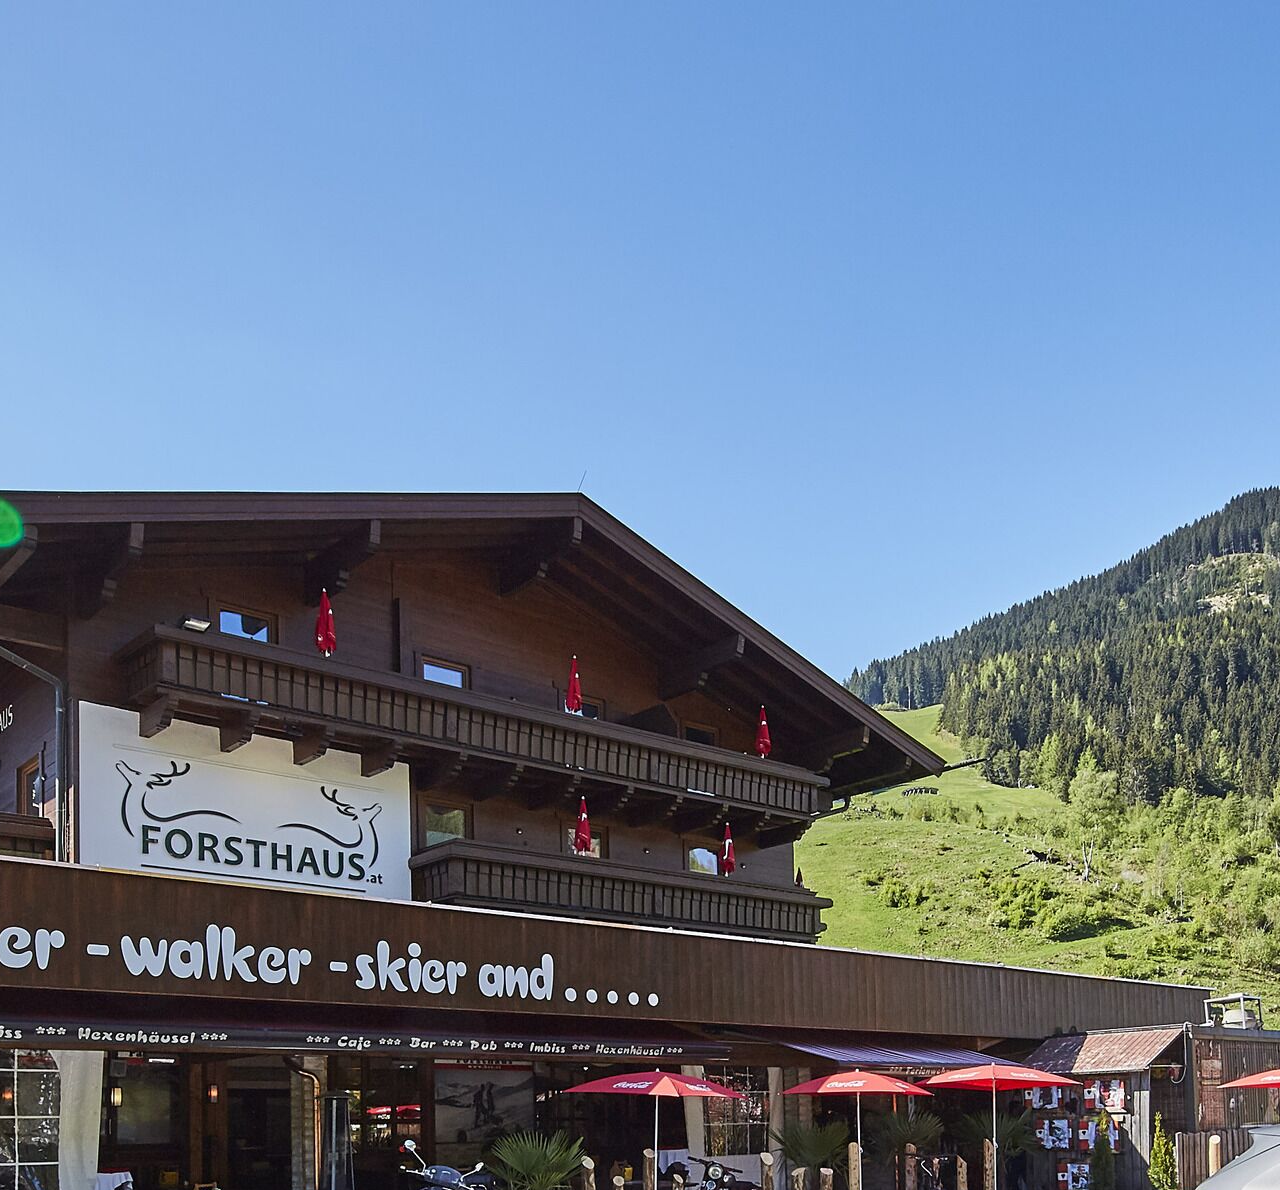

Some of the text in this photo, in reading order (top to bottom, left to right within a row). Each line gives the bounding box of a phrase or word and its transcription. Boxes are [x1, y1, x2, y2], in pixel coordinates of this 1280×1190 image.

[78, 1027, 196, 1045] Hexenhäusel
[337, 1036, 665, 1058] Cafe Bar Pub Imbiss Hexenhäusel
